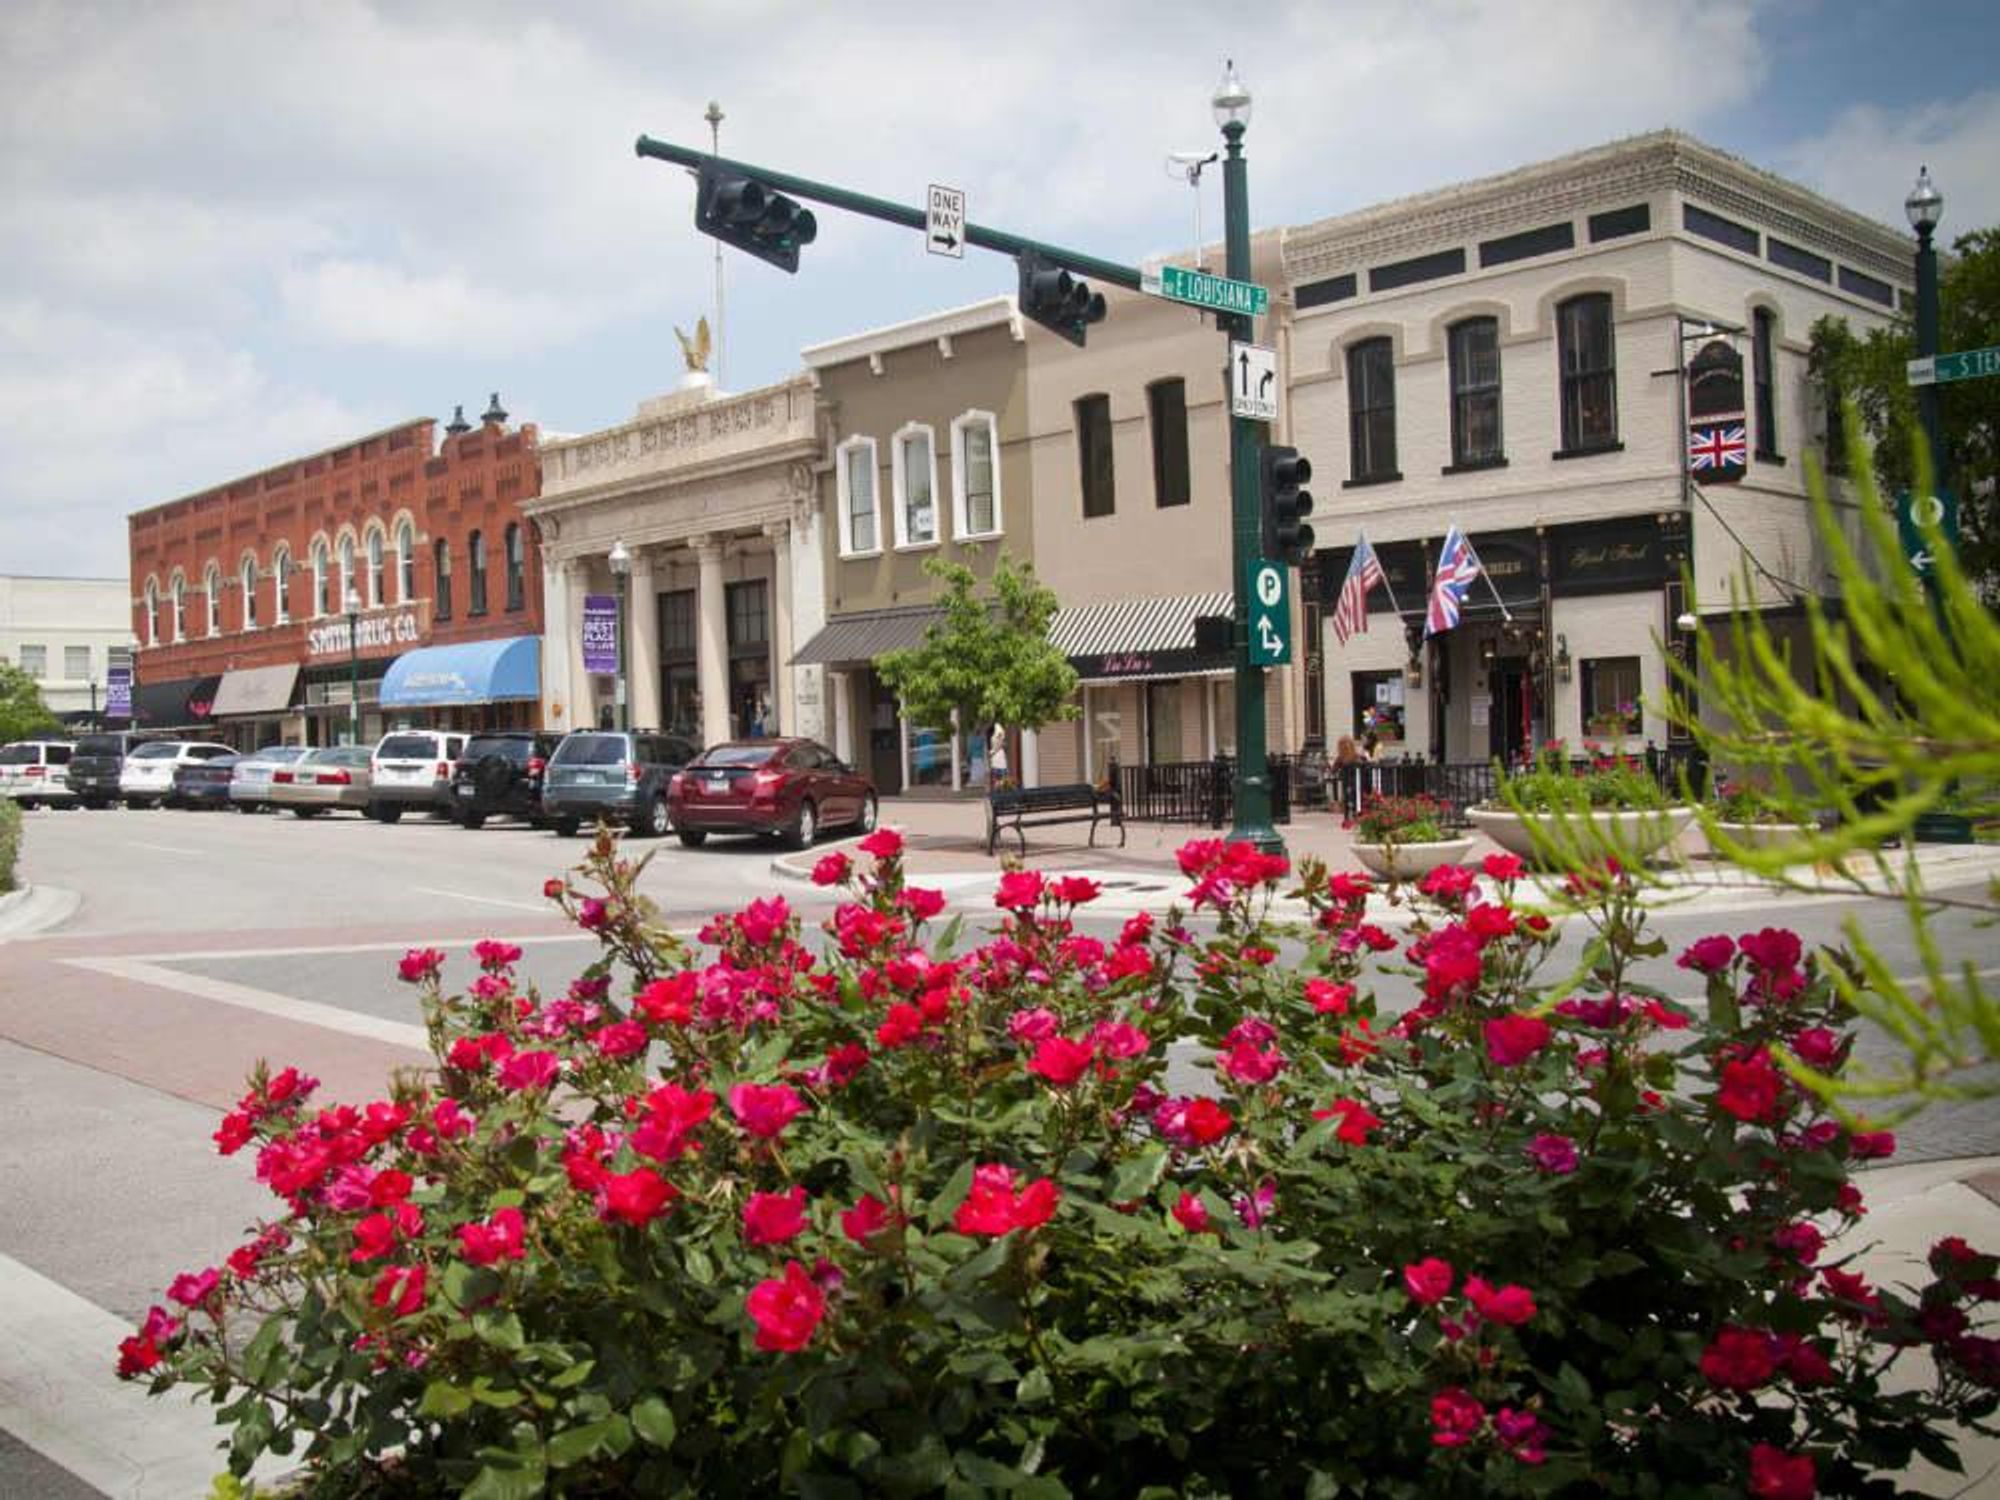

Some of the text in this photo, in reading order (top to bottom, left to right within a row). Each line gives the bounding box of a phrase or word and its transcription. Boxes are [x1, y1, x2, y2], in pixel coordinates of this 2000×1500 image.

[933, 191, 960, 212] ONE
[932, 210, 961, 229] WAY
[1176, 271, 1184, 297] E
[1188, 273, 1252, 311] LOUISIANA
[1959, 354, 1970, 377] S
[1264, 574, 1276, 599] P
[309, 623, 352, 655] SMITH
[354, 617, 391, 648] DRUG
